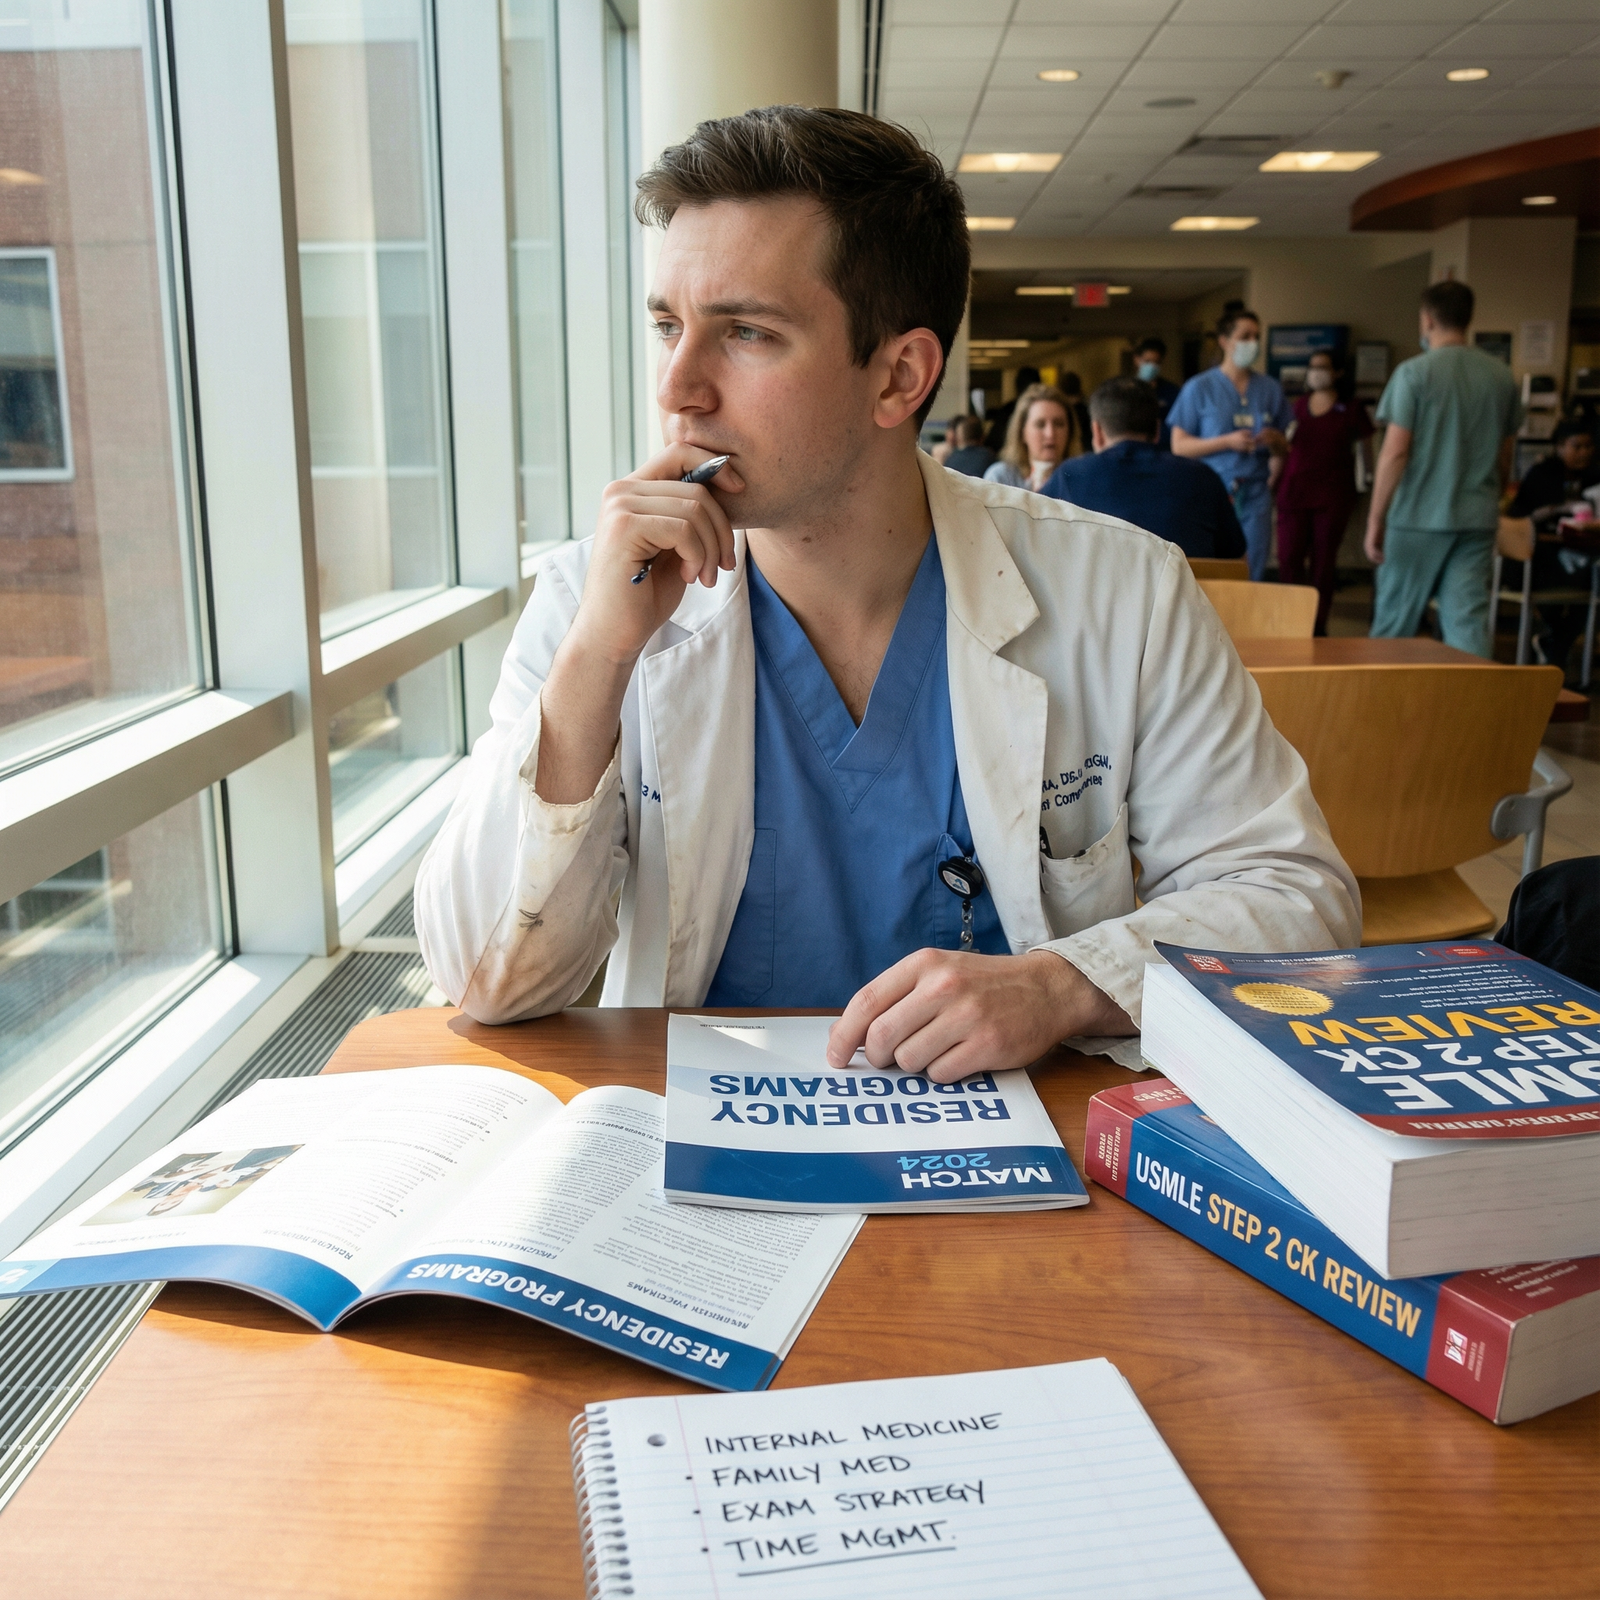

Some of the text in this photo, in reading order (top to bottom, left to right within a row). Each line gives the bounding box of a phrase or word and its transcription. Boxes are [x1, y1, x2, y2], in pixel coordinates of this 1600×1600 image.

[1288, 1000, 1600, 1046] REVIEW
[1313, 1030, 1600, 1073] TEP 2 CK
[710, 1098, 1011, 1126] RESIDENCY
[897, 1152, 991, 1171] 2024
[902, 1166, 1053, 1189] MATCH
[1135, 1151, 1203, 1215] USMLE
[1206, 1193, 1262, 1245] STEP
[1264, 1226, 1281, 1260] 2
[1285, 1238, 1319, 1282] CK
[1322, 1257, 1422, 1338] REVIEW
[406, 1262, 566, 1307] PROGRAMS
[563, 1297, 730, 1369] RESIDENCY
[705, 1412, 1002, 1454] INTERNAL MEDICINE
[712, 1455, 911, 1488] FAMILY MED
[721, 1480, 985, 1523] EXAM STRATEGY
[724, 1520, 957, 1563] TIME MGMT.
